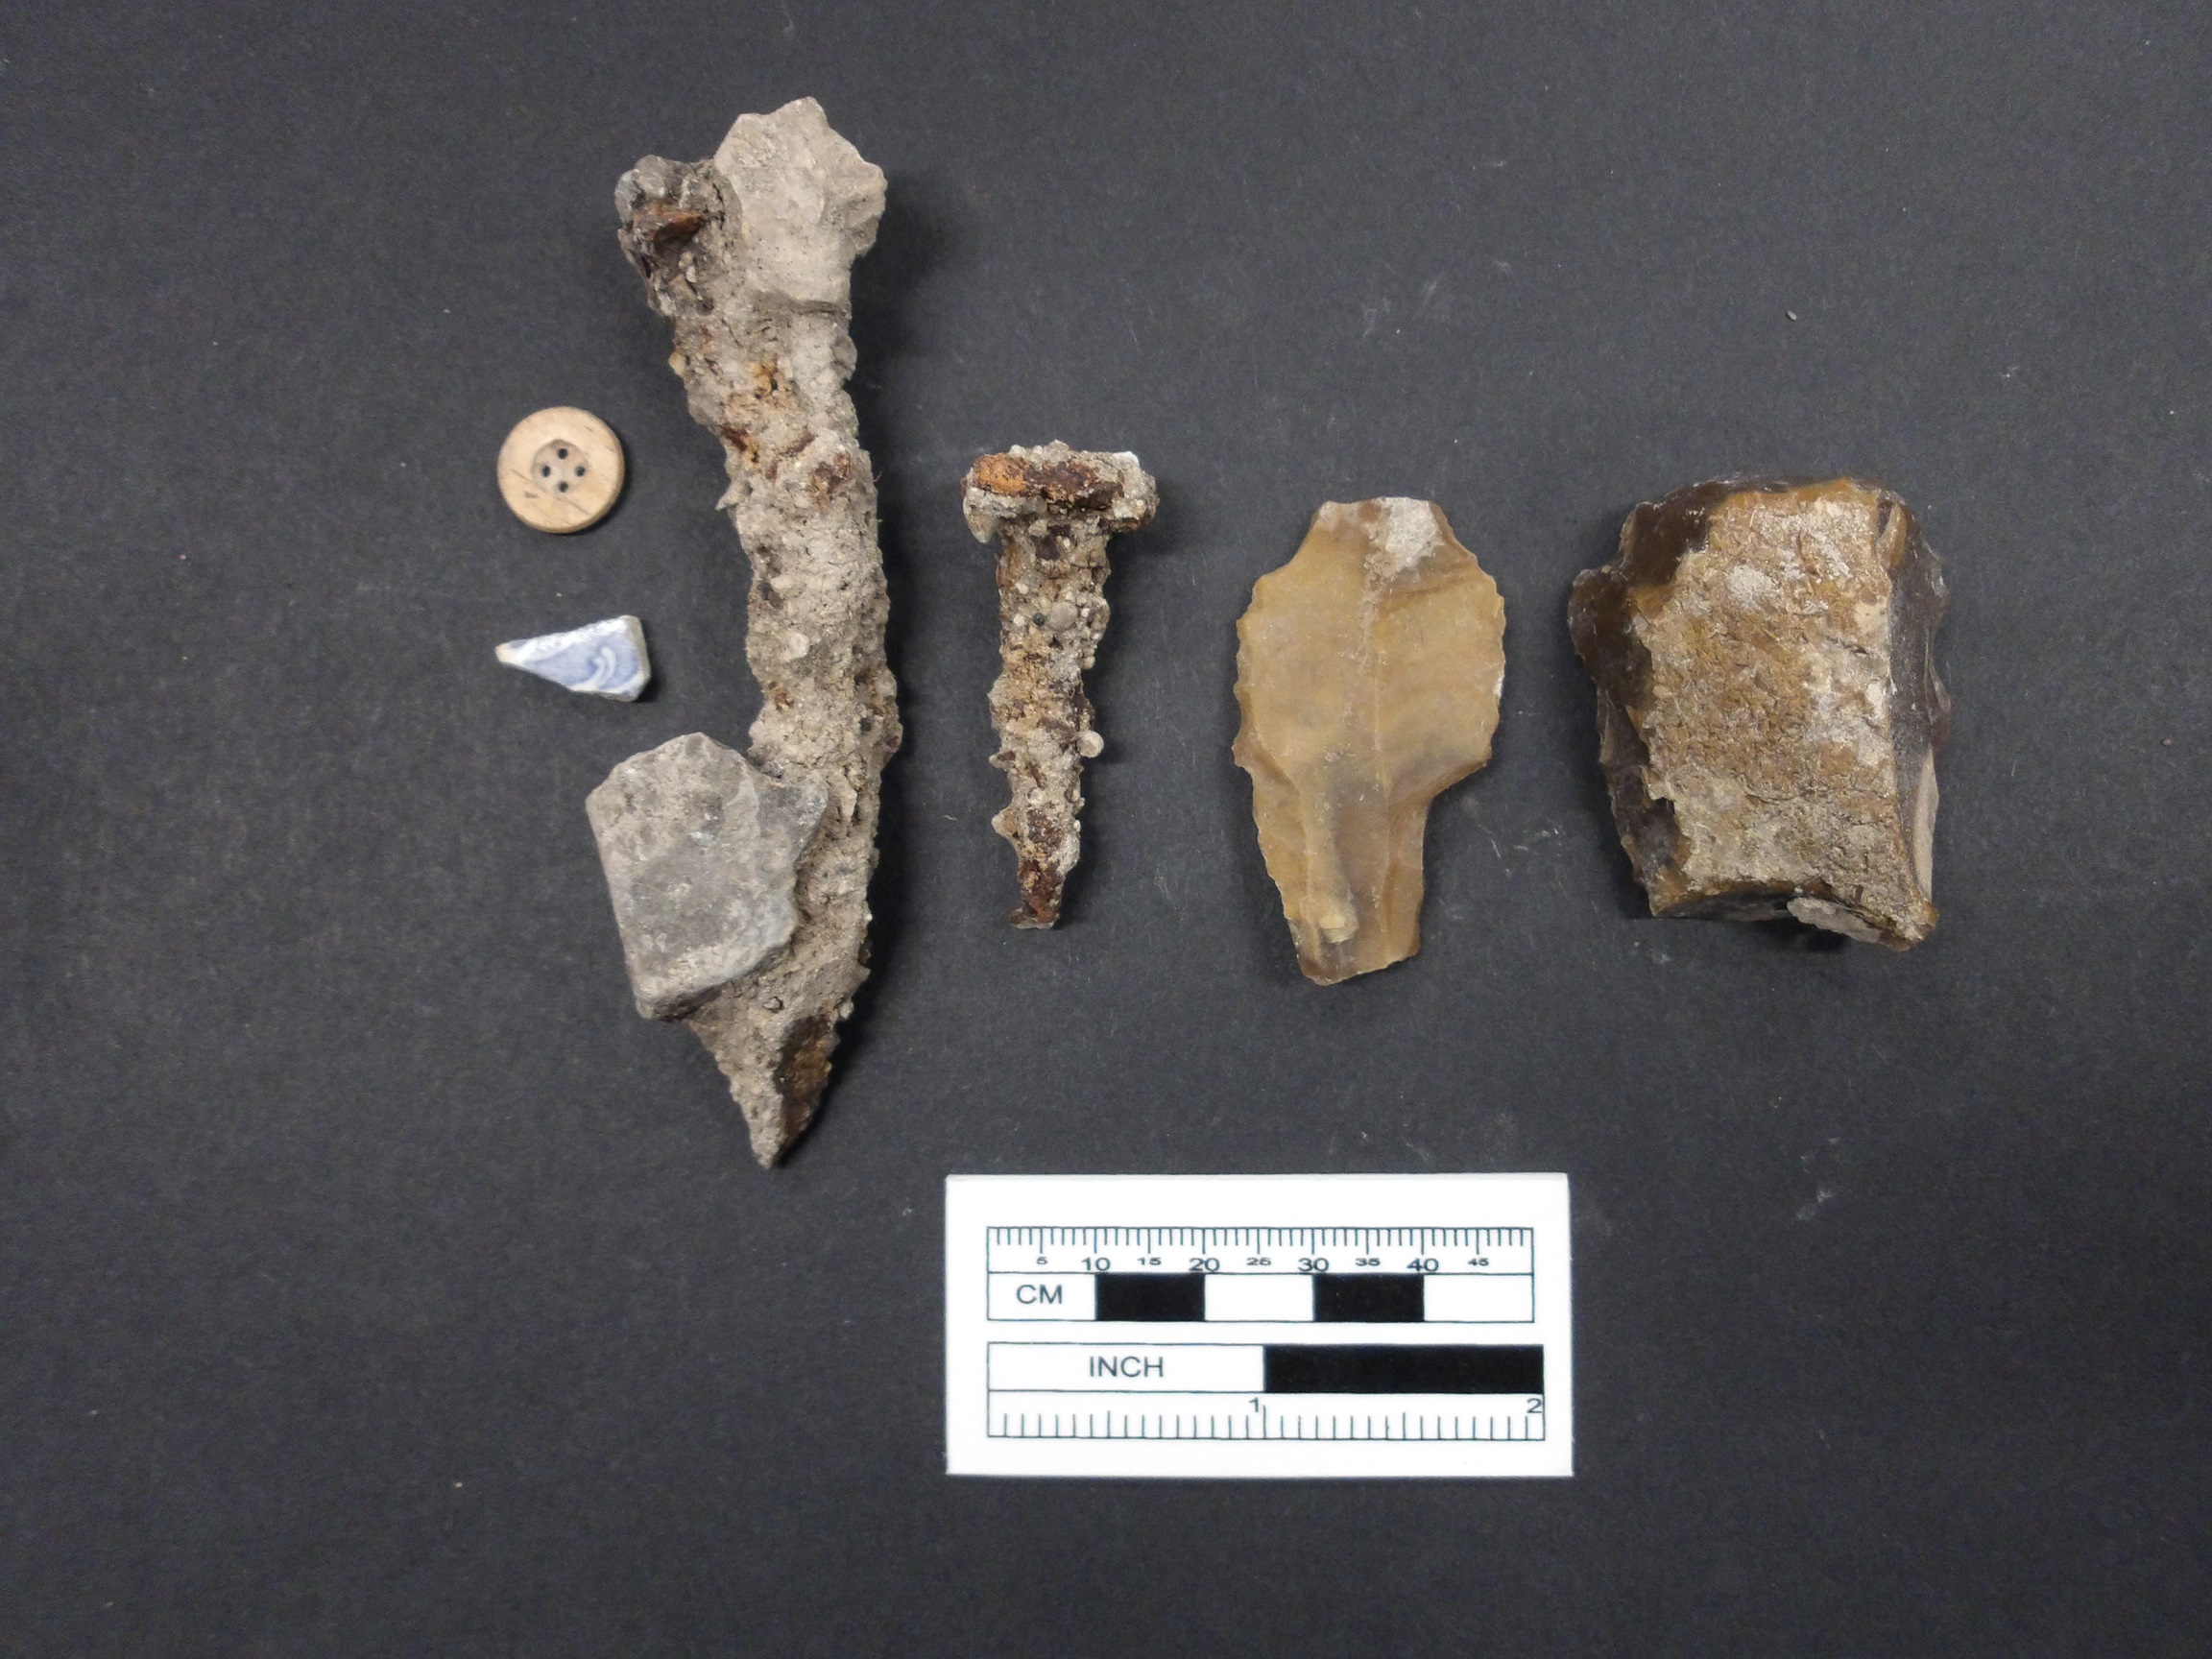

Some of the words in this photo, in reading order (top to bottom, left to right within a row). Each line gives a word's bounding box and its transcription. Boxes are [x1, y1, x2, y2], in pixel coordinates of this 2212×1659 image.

[1036, 1257, 1048, 1265] 5
[1081, 1258, 1111, 1272] 10
[1189, 1258, 1221, 1273] 20
[1247, 1258, 1271, 1266] 25
[1297, 1258, 1330, 1273] 30
[1356, 1258, 1381, 1266] 35
[1407, 1258, 1439, 1273] 40
[1468, 1258, 1489, 1266] 45
[1016, 1285, 1062, 1304] CM
[1090, 1356, 1163, 1378] INCH
[1249, 1398, 1259, 1412] 1
[1527, 1399, 1542, 1414] 2
